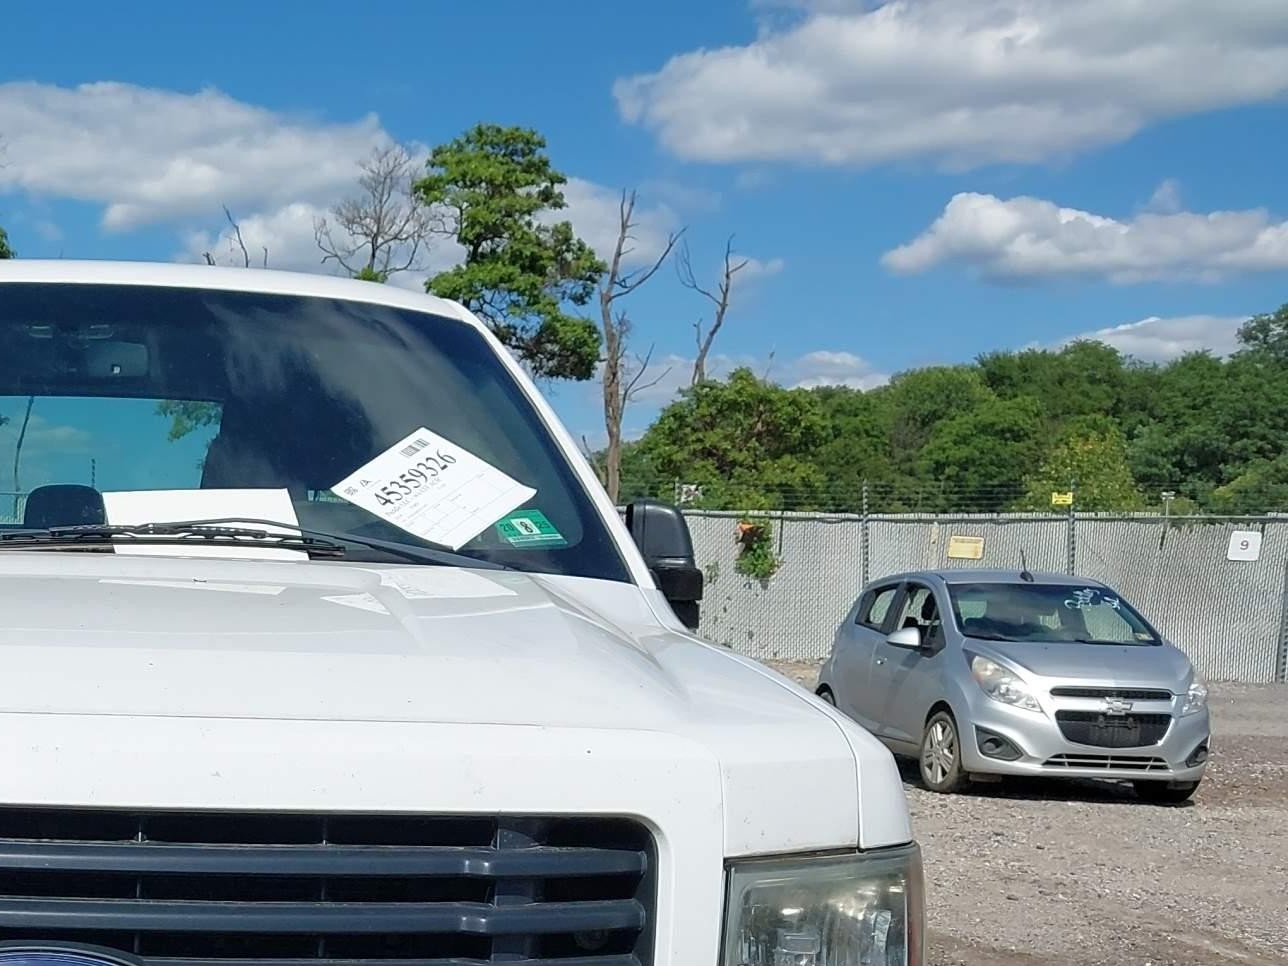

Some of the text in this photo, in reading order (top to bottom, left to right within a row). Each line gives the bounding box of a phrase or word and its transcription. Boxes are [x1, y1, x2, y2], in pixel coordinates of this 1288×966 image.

[373, 448, 457, 507] 45359326
[519, 521, 534, 534] 8
[1239, 539, 1249, 551] 9
